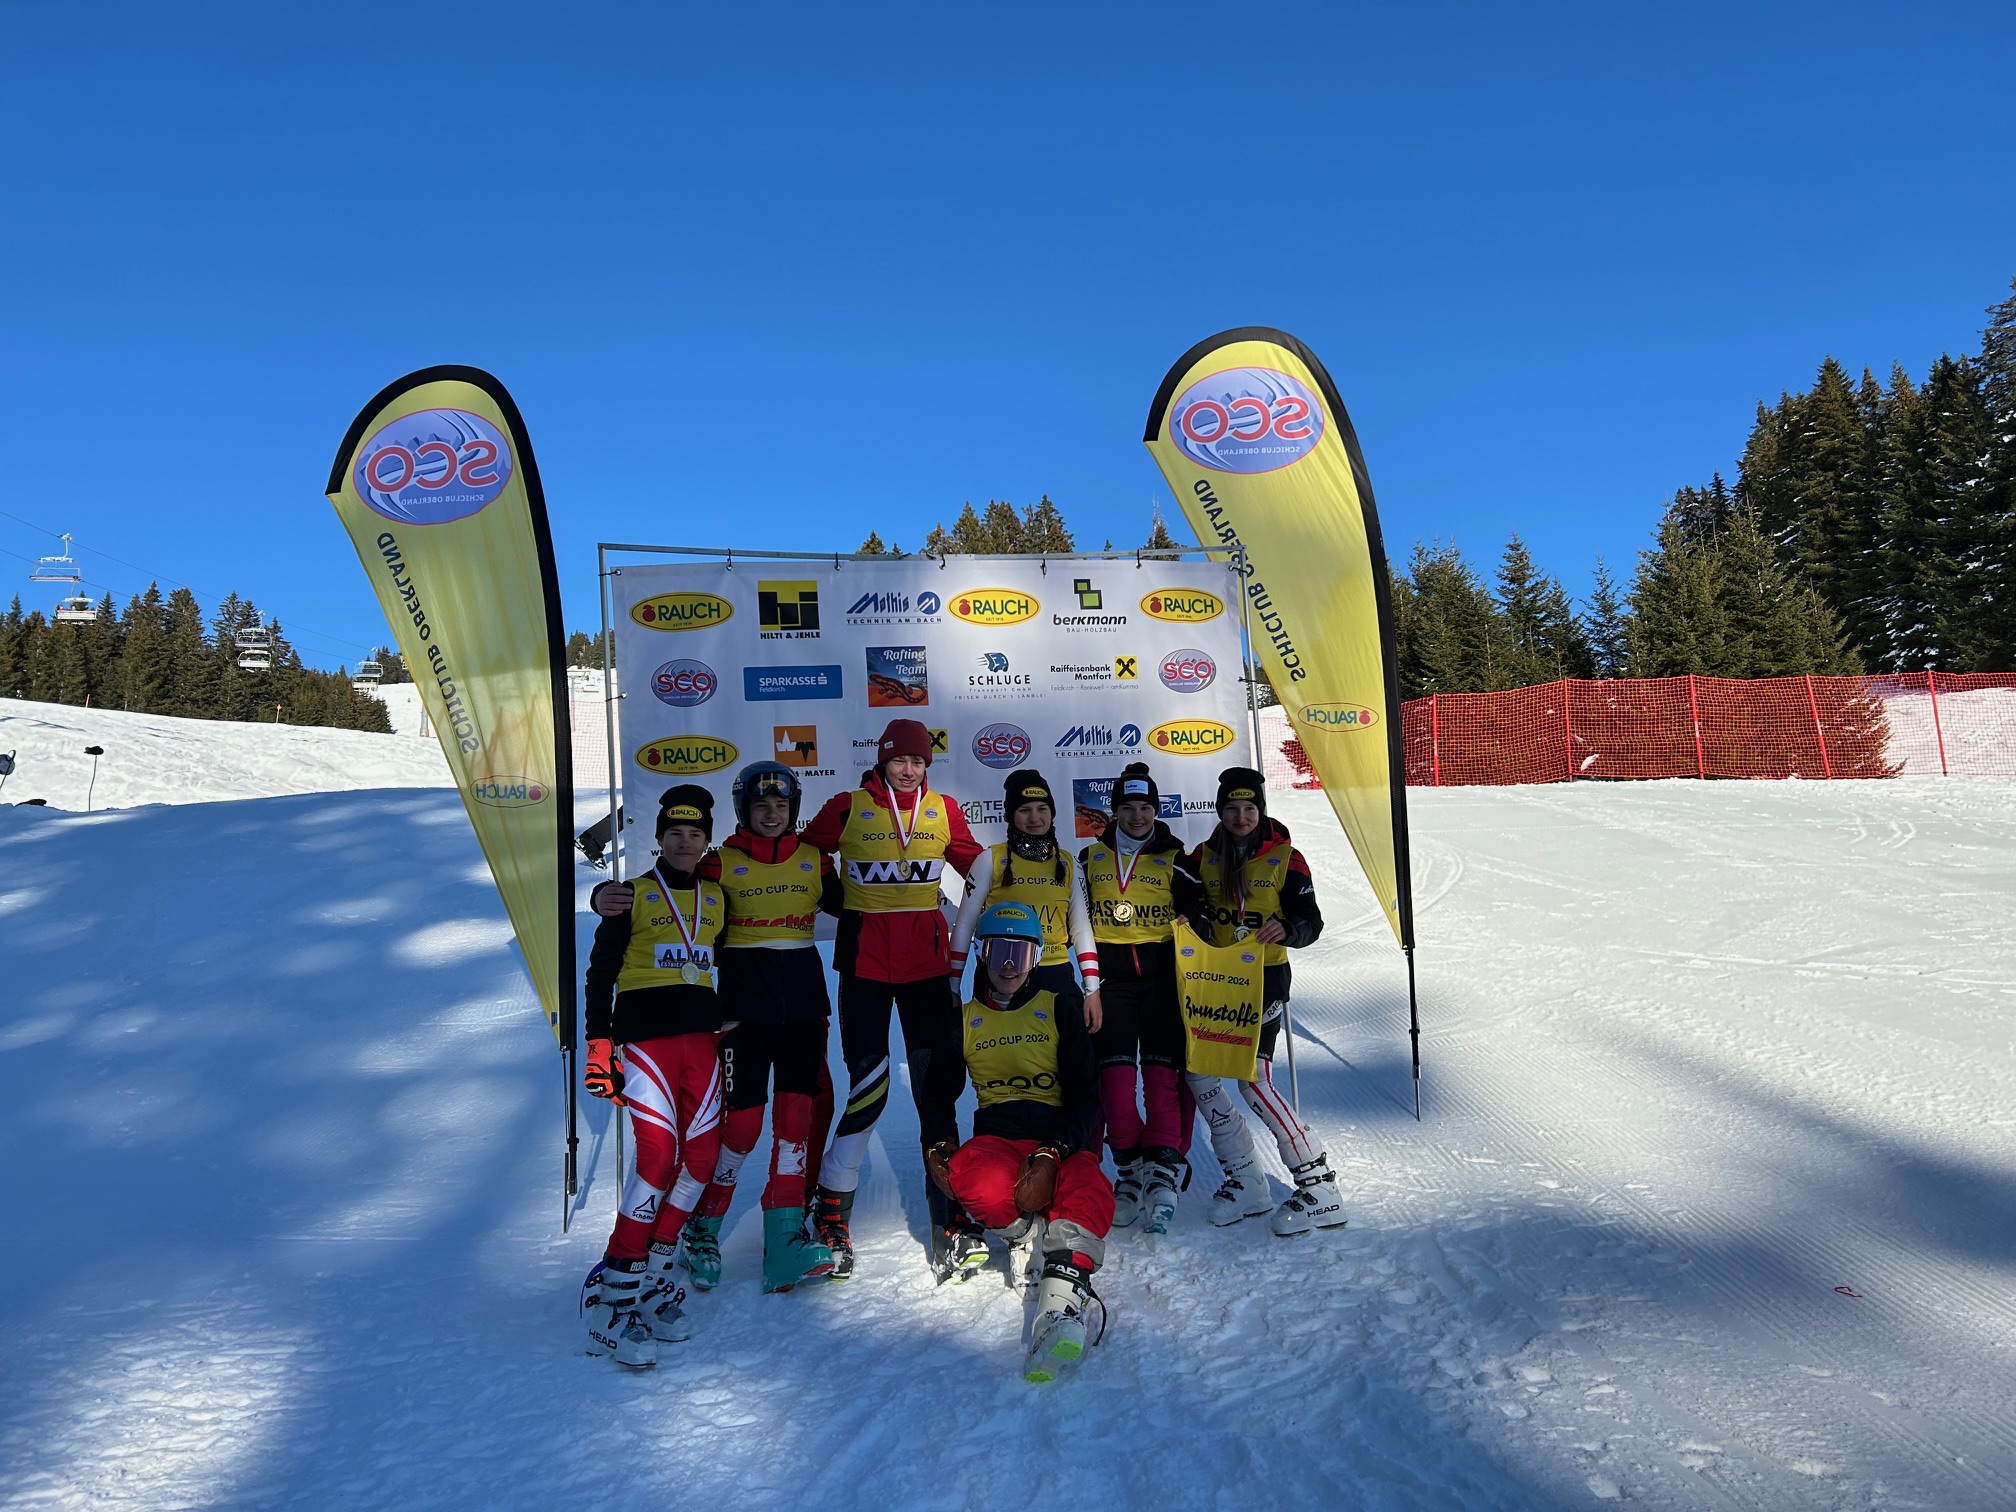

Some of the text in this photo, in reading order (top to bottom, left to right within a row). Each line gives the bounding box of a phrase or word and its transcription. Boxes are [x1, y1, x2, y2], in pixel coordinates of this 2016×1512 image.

[846, 591, 910, 614] Mathis
[973, 599, 1029, 615] RAUCH
[1164, 597, 1215, 614] RAUCH
[658, 602, 721, 621] RAUCH
[1053, 614, 1127, 626] berkmann
[760, 632, 782, 640] HILTI
[795, 631, 821, 639] JEHLE
[883, 649, 926, 662] Rafting
[895, 664, 925, 675] Team
[1051, 664, 1110, 673] Raiffeisenbank
[1163, 661, 1213, 680] SCO
[657, 672, 713, 693] SCO
[758, 676, 817, 687] SPARKASSE
[968, 675, 1031, 685] SCHLUGE
[1075, 672, 1112, 680] Montfort
[1055, 725, 1113, 747] Mathis
[1171, 729, 1224, 746] RAUCH
[977, 736, 1027, 756] SCO
[663, 746, 726, 764] RAUCH
[1089, 781, 1115, 793] Rafti
[1183, 801, 1215, 811] KAUFM
[675, 808, 698, 818] RAUCH
[862, 832, 886, 841] SCO
[913, 831, 935, 841] 2024
[1027, 877, 1047, 885] CUP
[1095, 873, 1114, 883] SCO
[1140, 875, 1162, 887] 2024
[1253, 879, 1276, 888] 2024
[739, 887, 763, 898] SCO
[766, 885, 788, 894] CUP
[1002, 909, 1026, 918] RAUCH
[651, 915, 674, 926] SCO
[663, 948, 709, 965] ALMA
[1204, 972, 1226, 983] CUP
[1227, 975, 1251, 987] 2024
[975, 1033, 1050, 1051] SCO CUP 2024
[724, 1048, 734, 1093] POC
[1307, 1204, 1340, 1218] HEAD
[589, 1328, 619, 1350] HEAD
